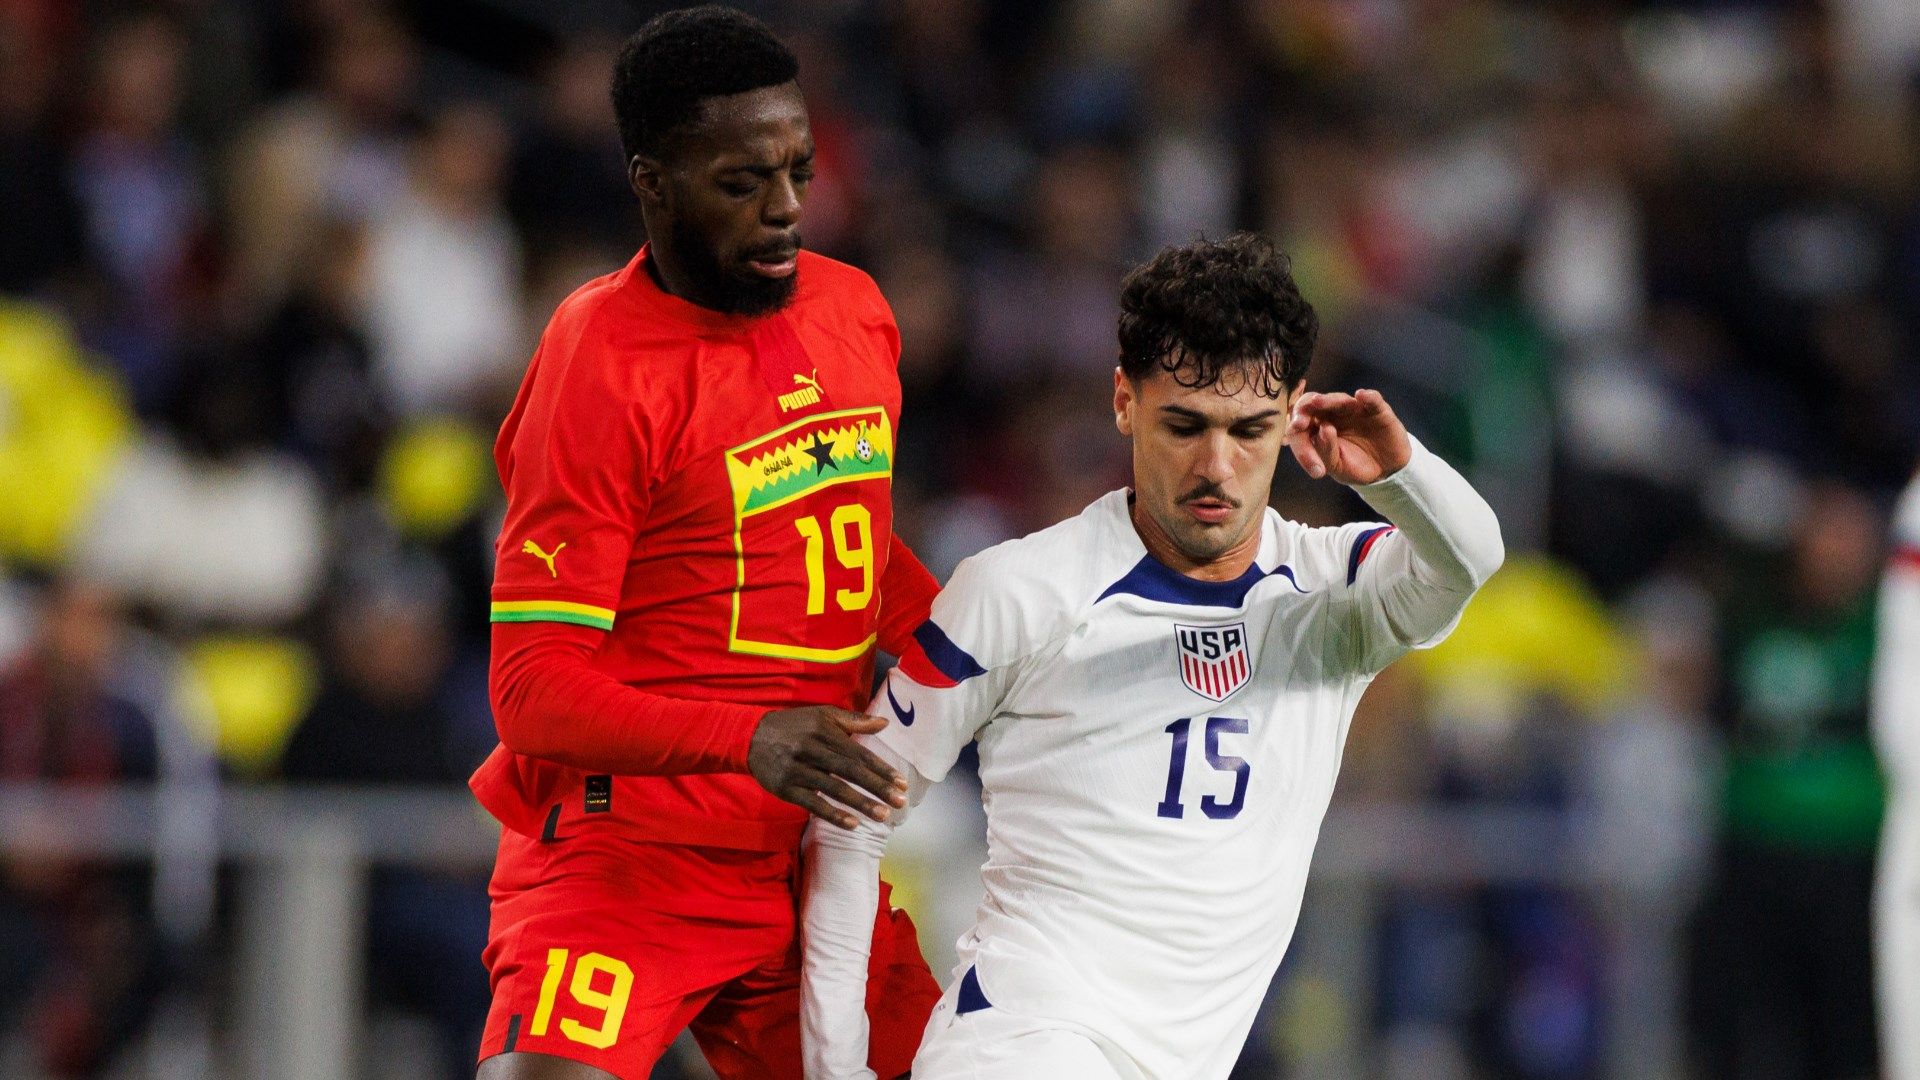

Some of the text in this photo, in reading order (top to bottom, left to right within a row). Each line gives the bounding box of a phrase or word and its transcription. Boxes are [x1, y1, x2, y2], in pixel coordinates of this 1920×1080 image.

[778, 386, 820, 412] PUMA
[763, 456, 793, 476] GHANA
[795, 503, 873, 615] 19
[1180, 628, 1241, 660] USA
[1157, 716, 1250, 819] 15
[530, 948, 634, 1049] 19
